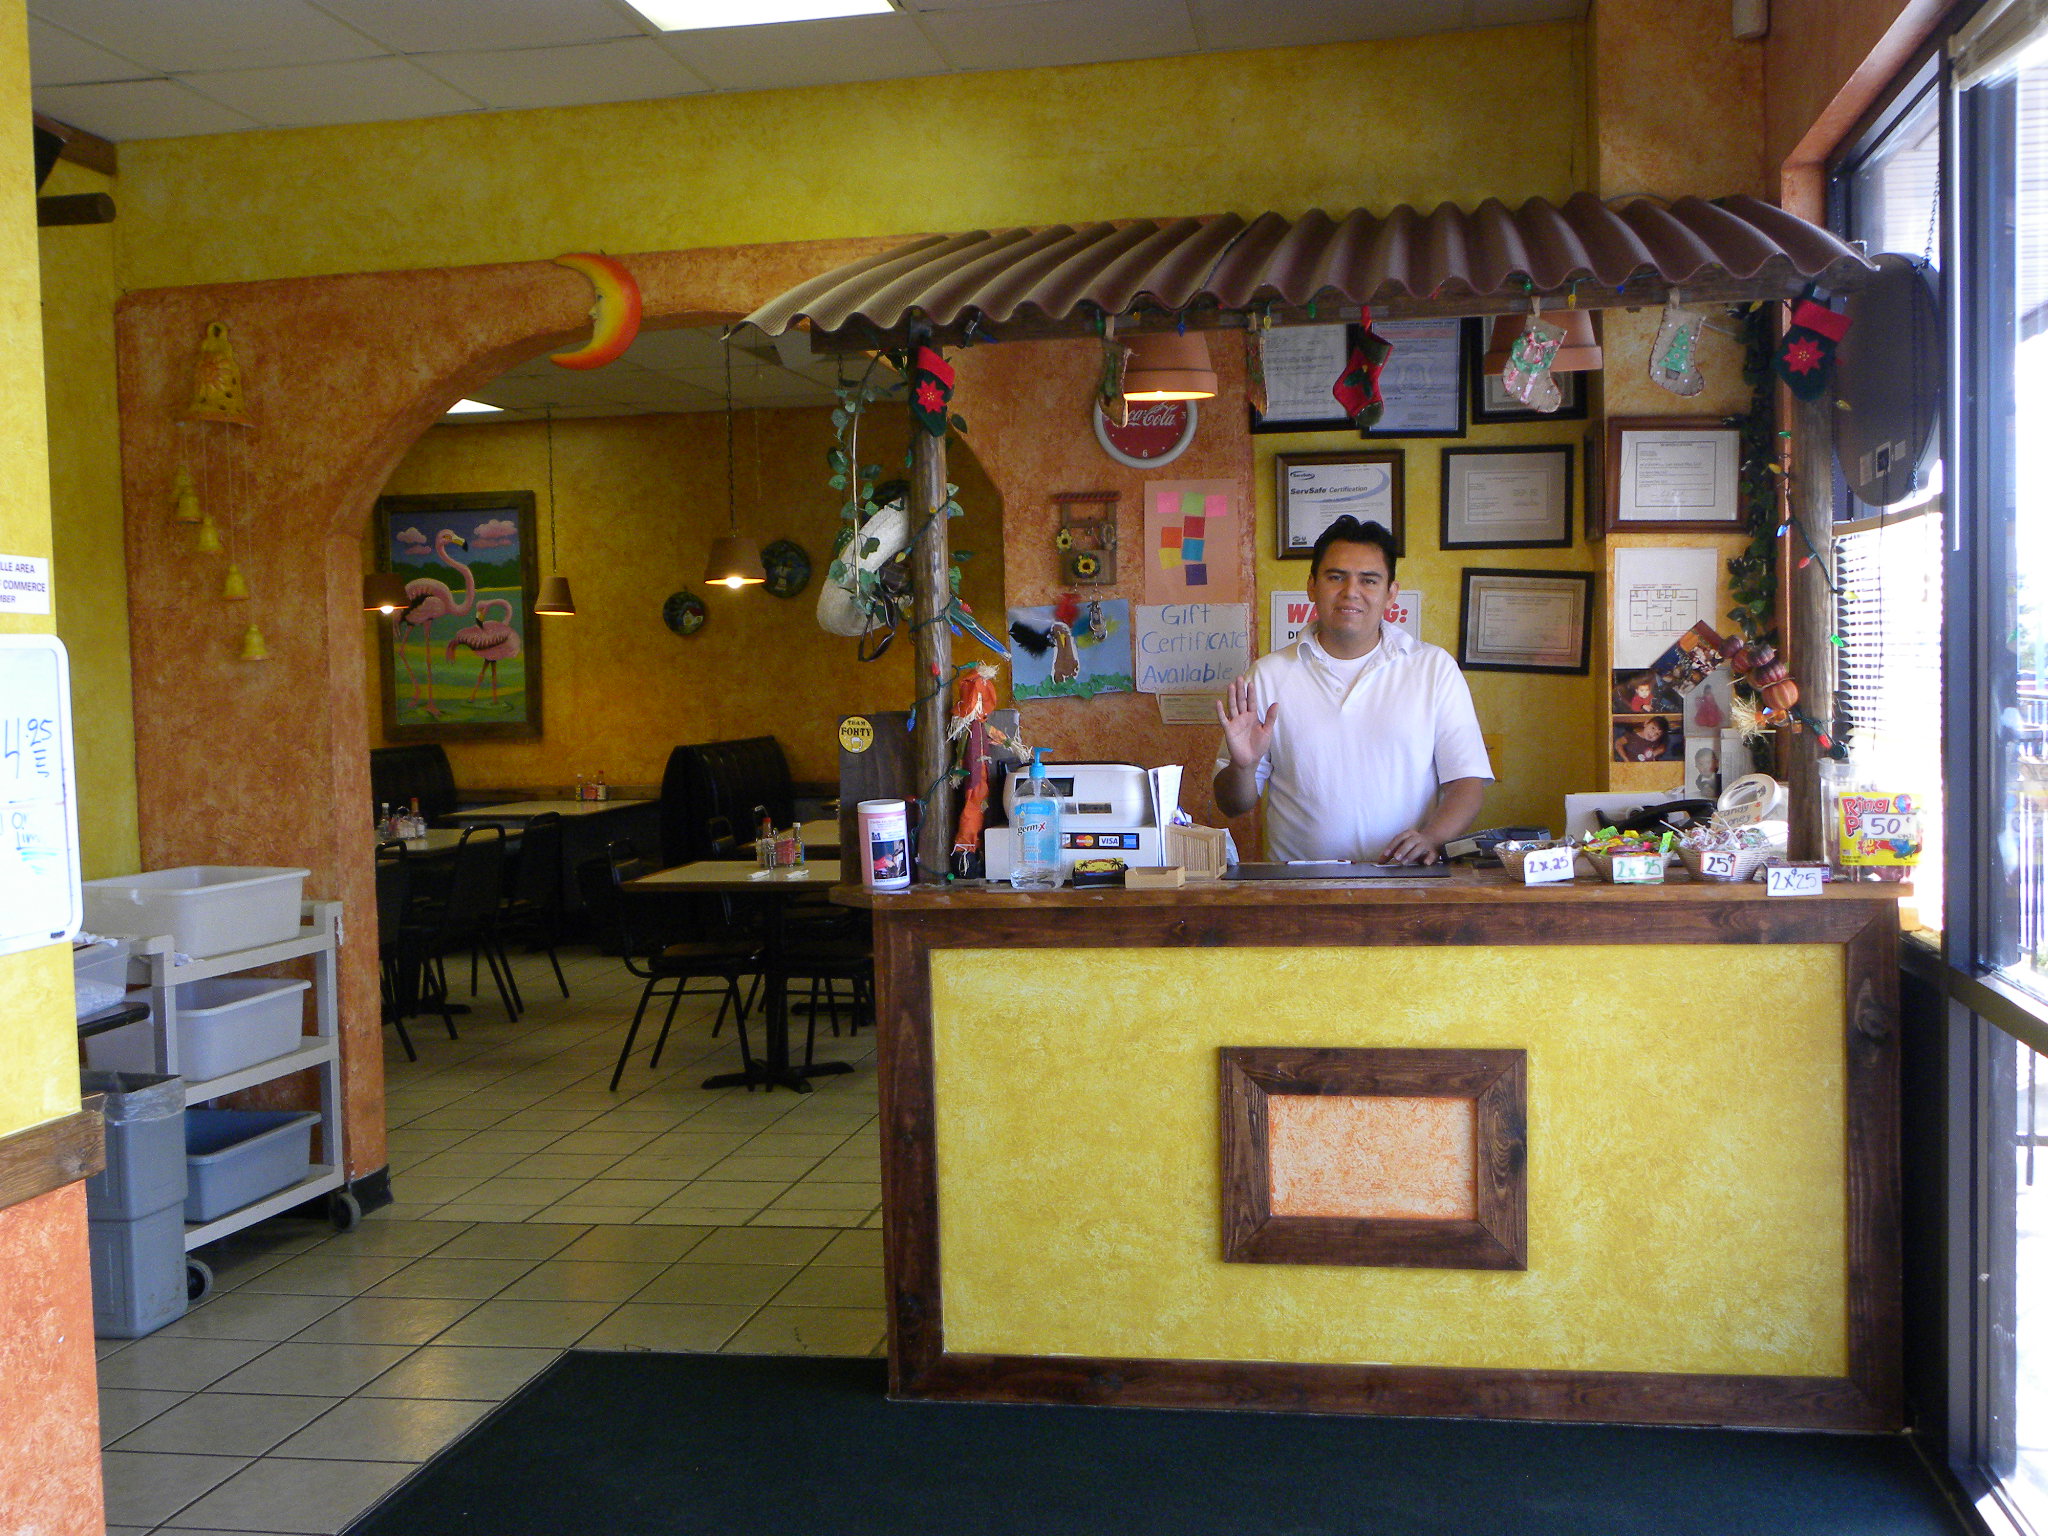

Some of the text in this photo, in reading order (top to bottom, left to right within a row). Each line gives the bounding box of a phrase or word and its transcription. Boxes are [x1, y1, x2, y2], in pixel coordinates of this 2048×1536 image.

[1290, 487, 1327, 495] ServSafe
[15, 563, 36, 574] AREA
[3, 580, 46, 592] COMMERCE
[1161, 604, 1210, 625] Gift
[1142, 663, 1233, 684] Available
[1842, 796, 1889, 818] Ring
